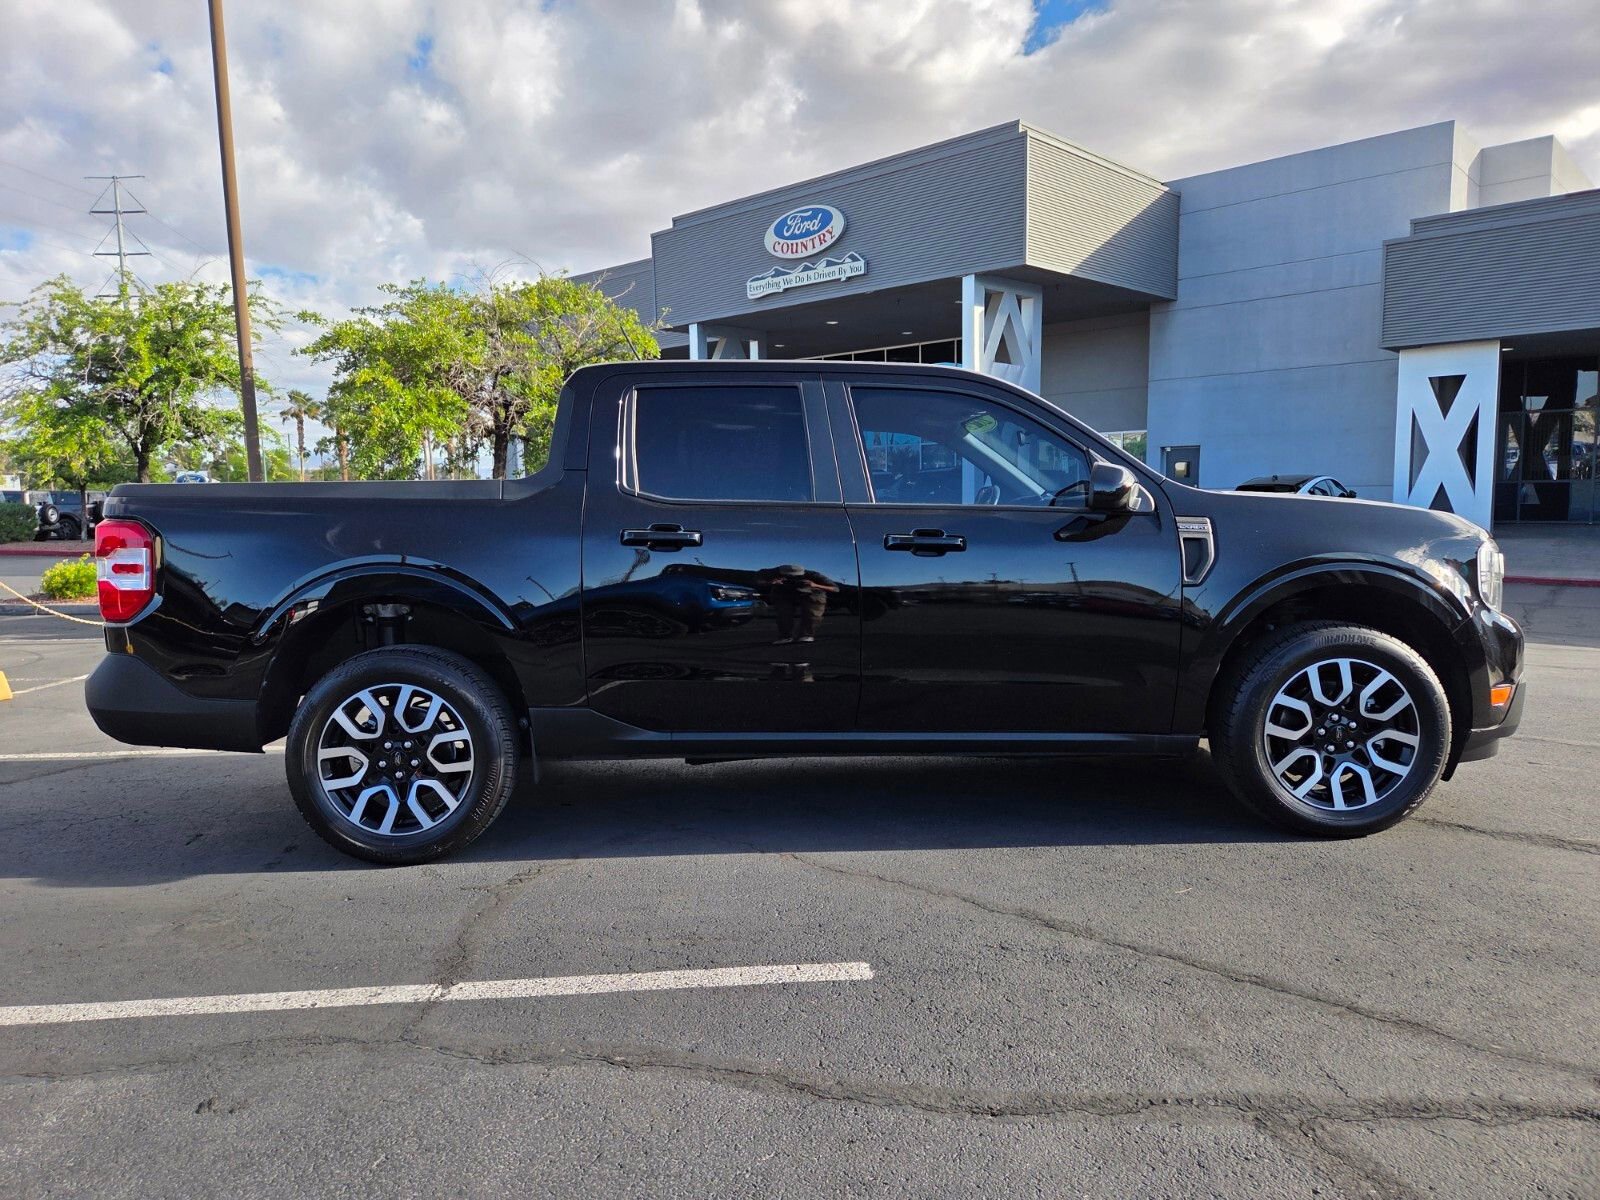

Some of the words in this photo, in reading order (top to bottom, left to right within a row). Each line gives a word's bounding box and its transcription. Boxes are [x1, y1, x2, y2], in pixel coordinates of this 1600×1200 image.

[783, 211, 822, 237] Ford
[772, 227, 835, 254] COUNTRY
[749, 280, 782, 292] Everything
[782, 277, 794, 287] We
[795, 275, 805, 284] Do
[806, 272, 812, 281] Is
[813, 267, 836, 280] Driven
[838, 265, 847, 277] By
[849, 264, 862, 274] You
